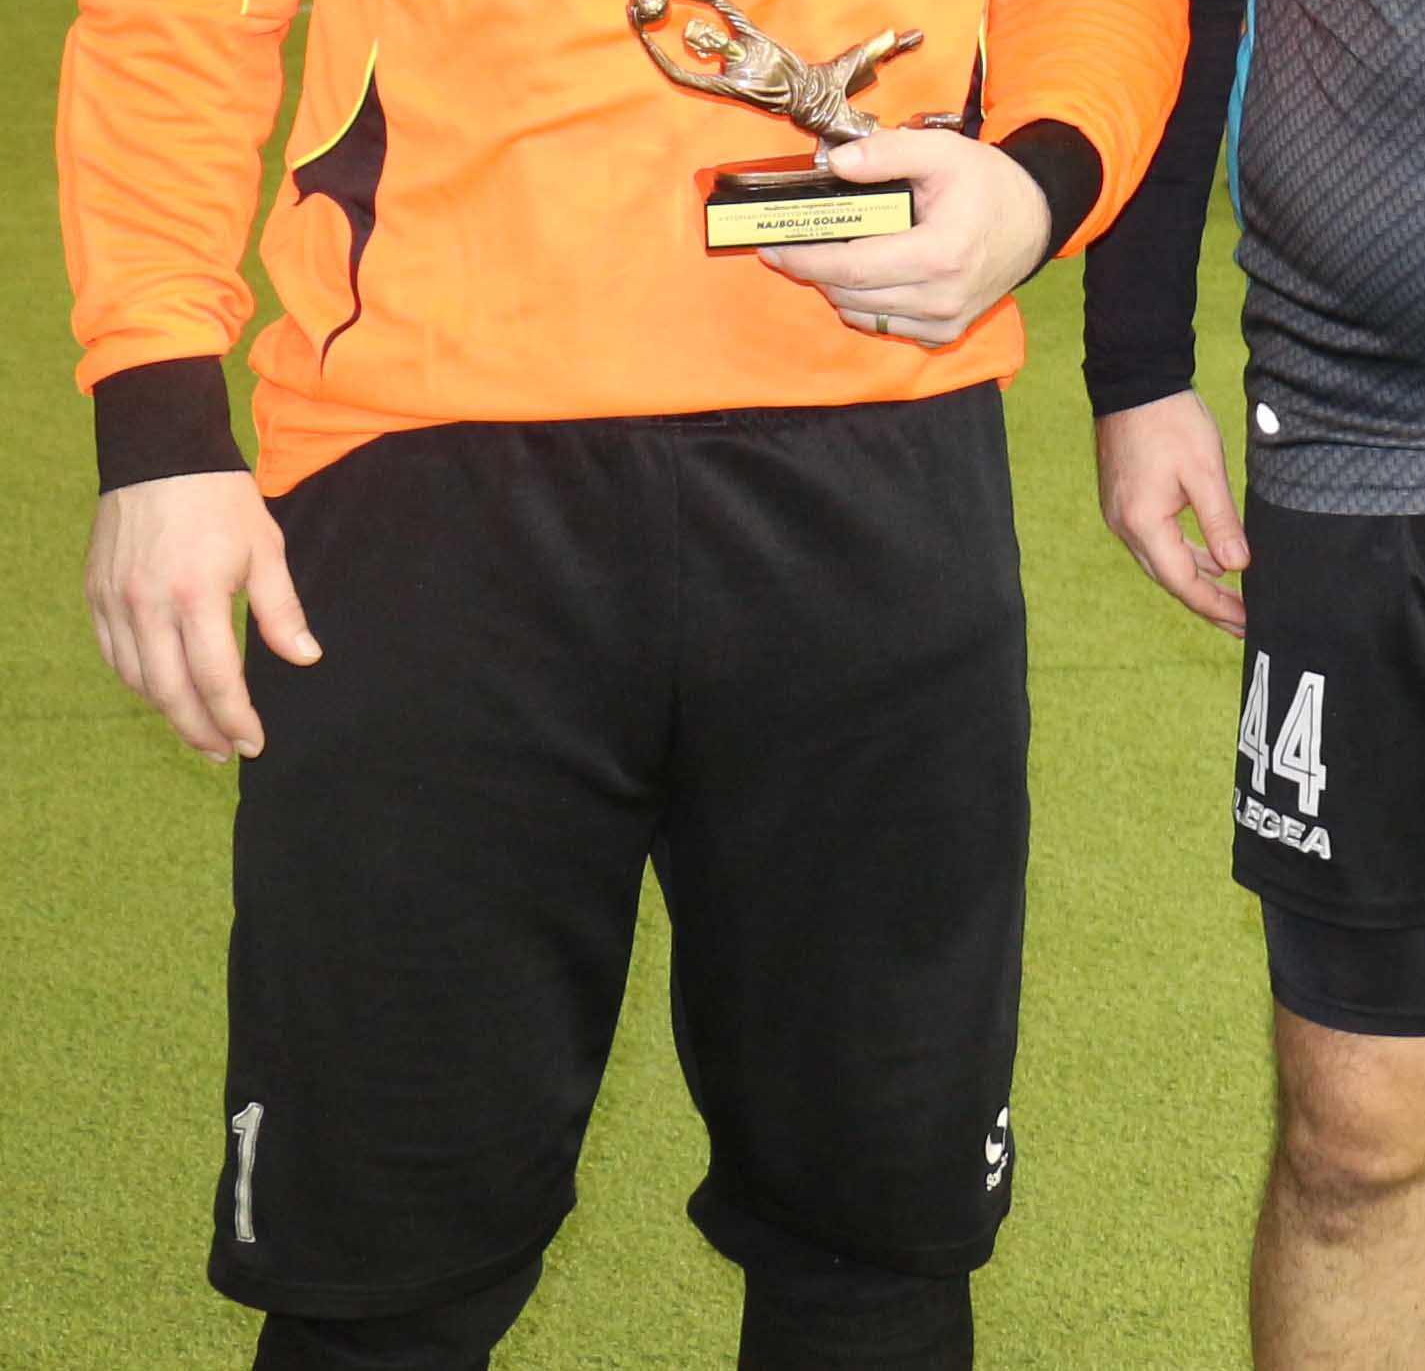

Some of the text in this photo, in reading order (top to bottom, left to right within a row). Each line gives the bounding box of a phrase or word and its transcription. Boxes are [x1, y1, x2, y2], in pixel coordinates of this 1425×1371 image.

[756, 215, 862, 230] NAJBOLJI GOLMAN
[1238, 650, 1327, 818] 44
[232, 1101, 265, 1244] 1
